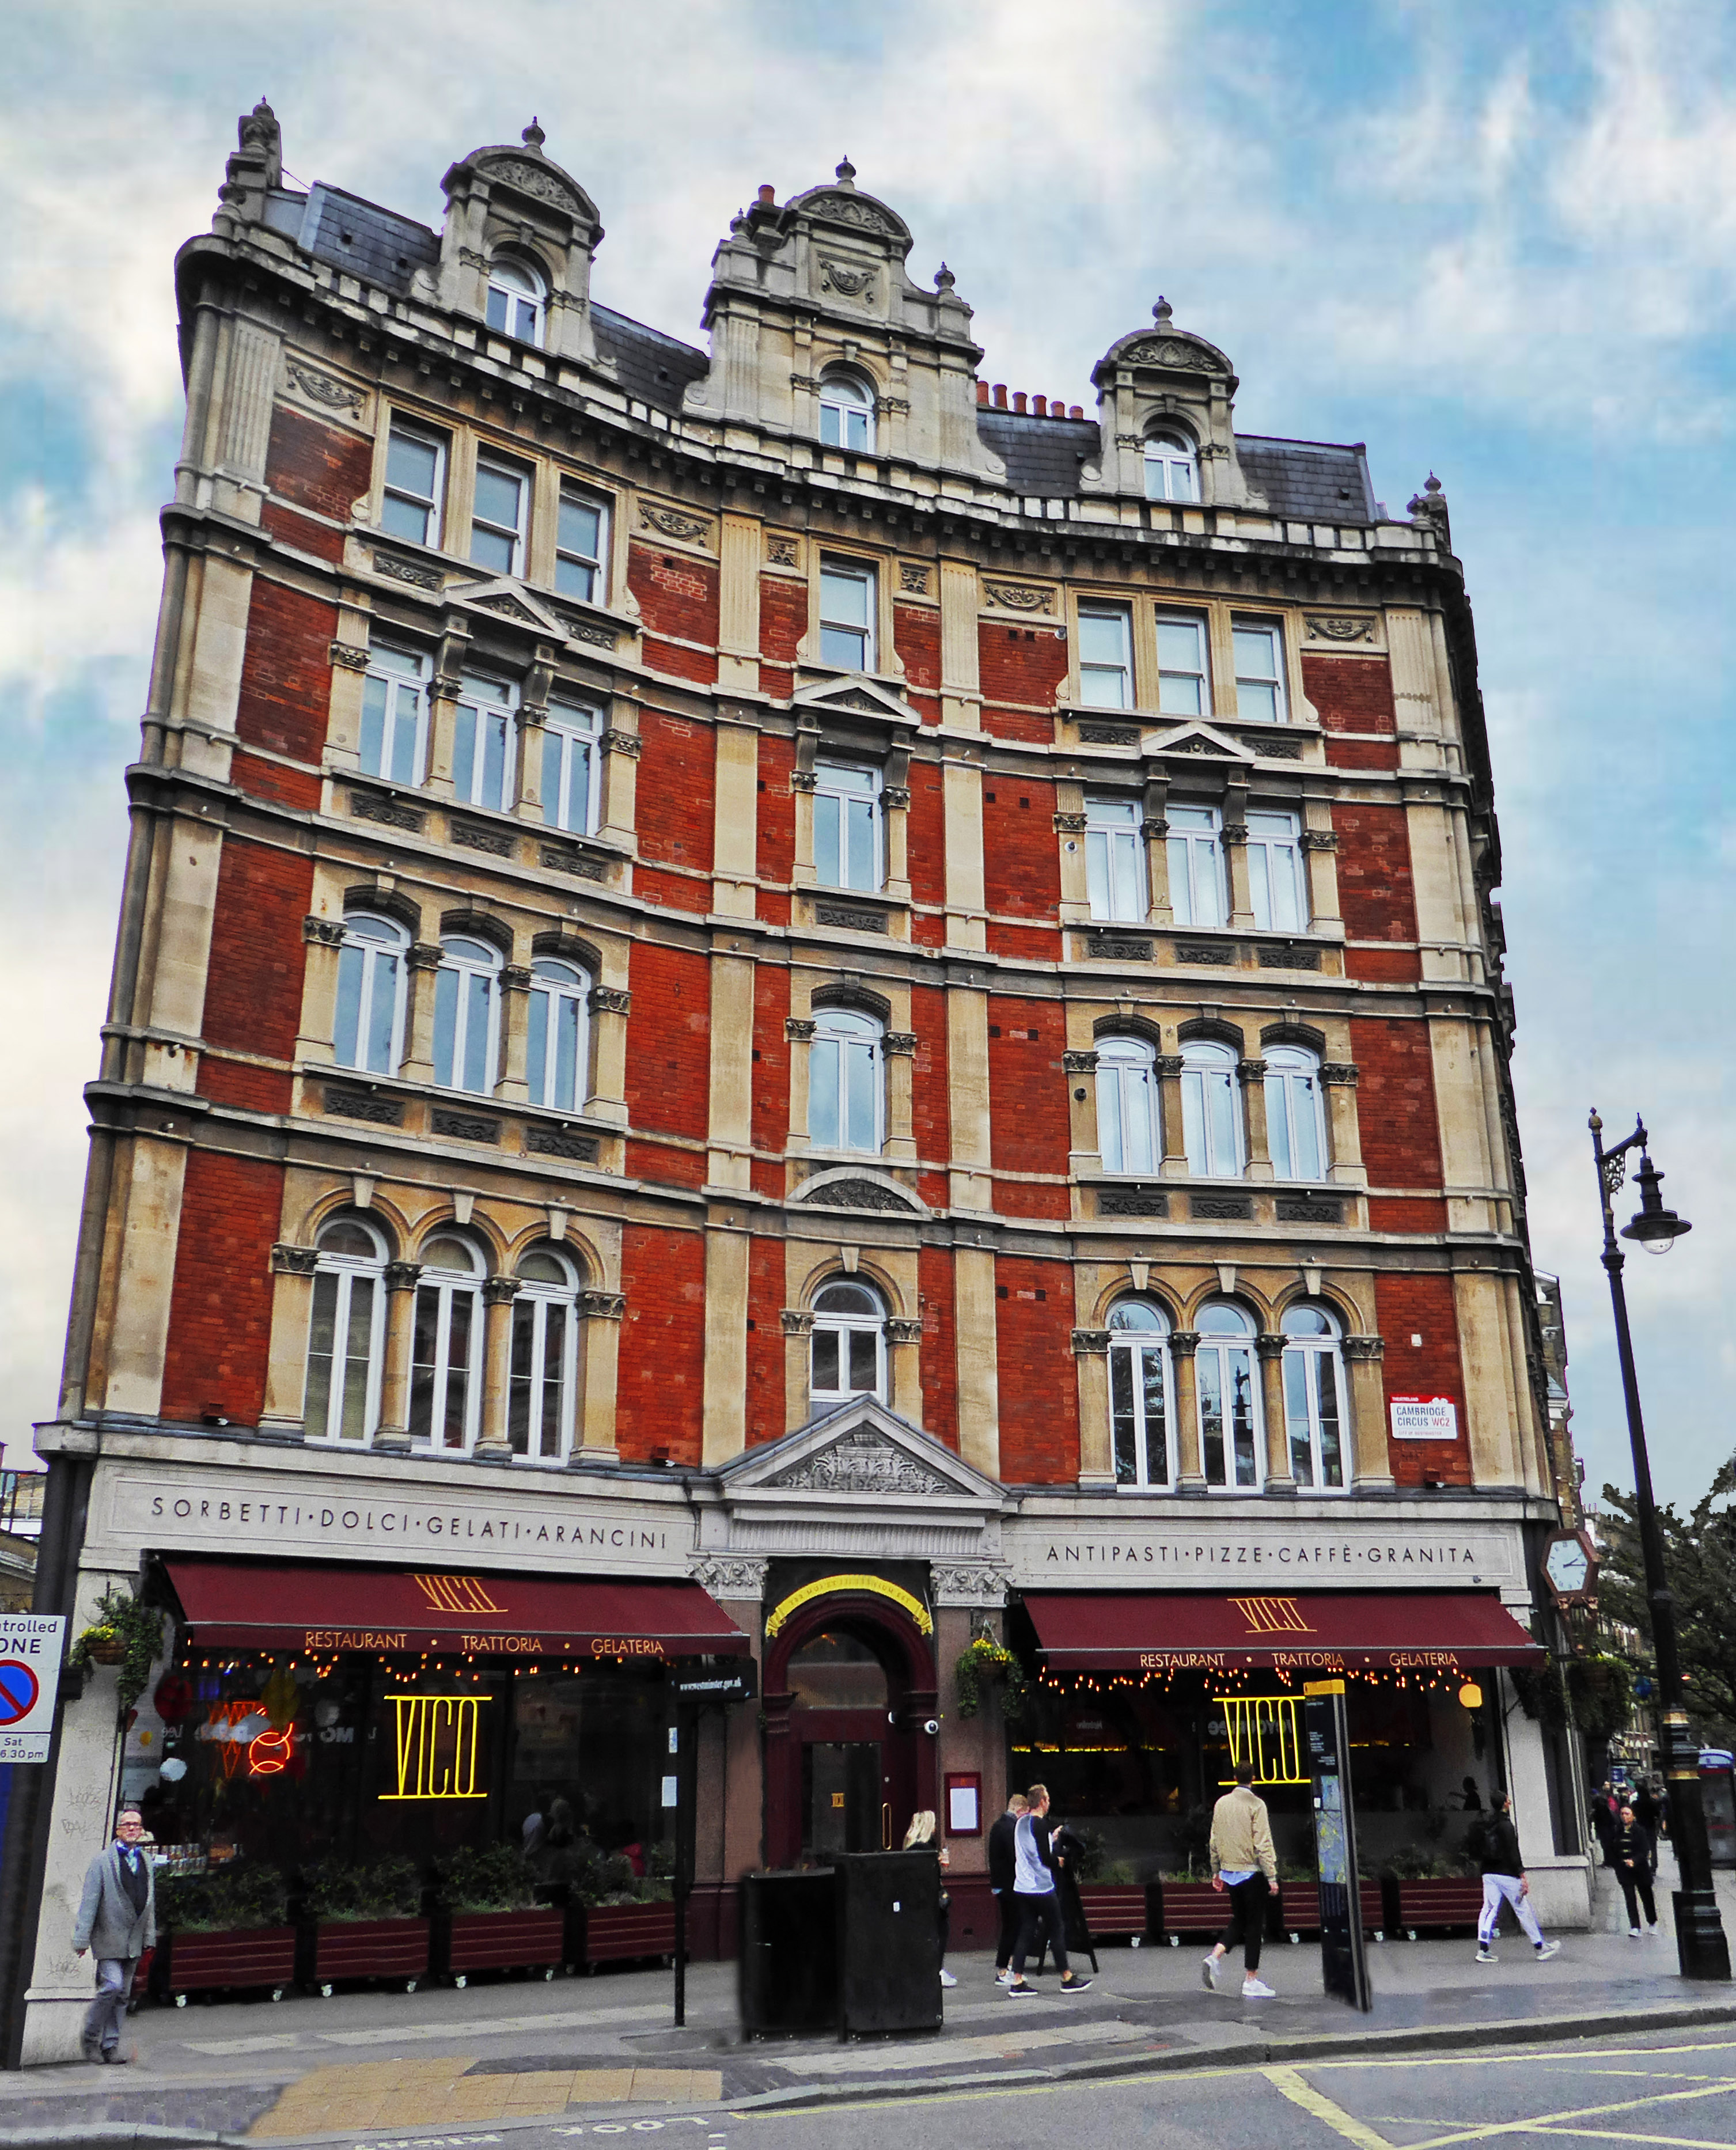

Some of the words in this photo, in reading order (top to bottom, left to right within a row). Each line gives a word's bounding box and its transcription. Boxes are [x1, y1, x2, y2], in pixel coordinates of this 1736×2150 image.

[1396, 1405, 1447, 1416] CAMBRIDGE
[1397, 1417, 1428, 1427] CIRCUS
[1431, 1417, 1450, 1427] WC2
[153, 1497, 300, 1524] SORBETTI
[321, 1509, 407, 1531] DOLCI
[427, 1516, 519, 1538] GELATI
[537, 1525, 665, 1548] ARANCINI
[1047, 1546, 1178, 1561] ANTIPASTI
[1196, 1547, 1261, 1563] PIZZE
[1279, 1544, 1351, 1563] CAFFÈ
[1367, 1548, 1474, 1563] GRANITA
[0, 1620, 58, 1633] trolled
[305, 1632, 407, 1648] RESTAURANT
[461, 1635, 543, 1652] TRATTORIA
[592, 1639, 664, 1654] GELATERIA
[1140, 1654, 1225, 1667] RESTAURANT
[1271, 1653, 1345, 1666] TRATTORIA
[1390, 1653, 1458, 1666] GELATERIA
[4, 1738, 22, 1746] Sat
[380, 1696, 491, 1799] VICO
[1214, 1696, 1310, 1784] VICO
[551, 2117, 709, 2136] LOOK
